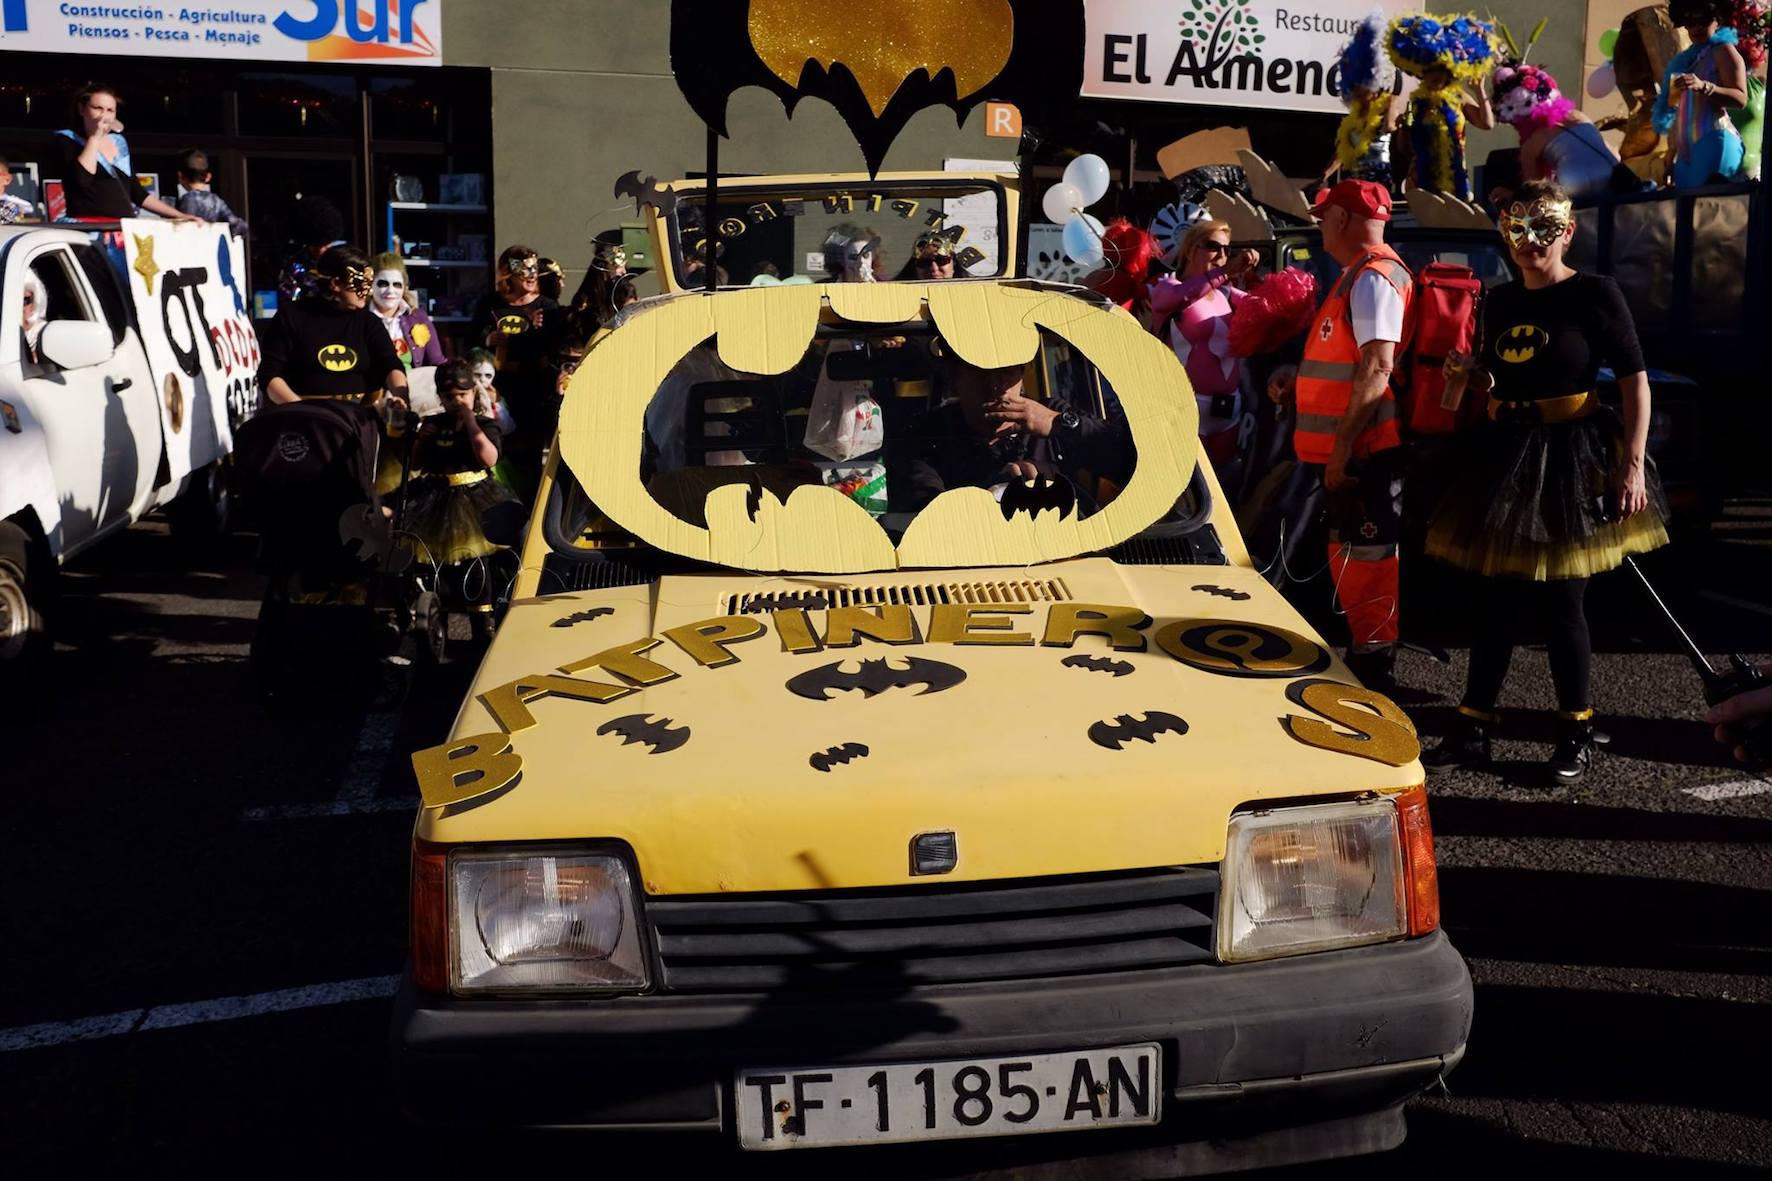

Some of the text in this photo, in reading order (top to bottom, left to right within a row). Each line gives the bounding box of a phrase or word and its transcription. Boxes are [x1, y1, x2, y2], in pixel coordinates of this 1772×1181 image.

[59, 3, 163, 21] Construcción
[179, 8, 267, 24] Agricultura
[1276, 8, 1358, 35] Restaur
[68, 24, 129, 39] Piensos
[144, 27, 189, 41] Pesca
[205, 29, 260, 45] Menaje
[1103, 33, 1403, 97] El Almen
[995, 107, 1014, 133] R
